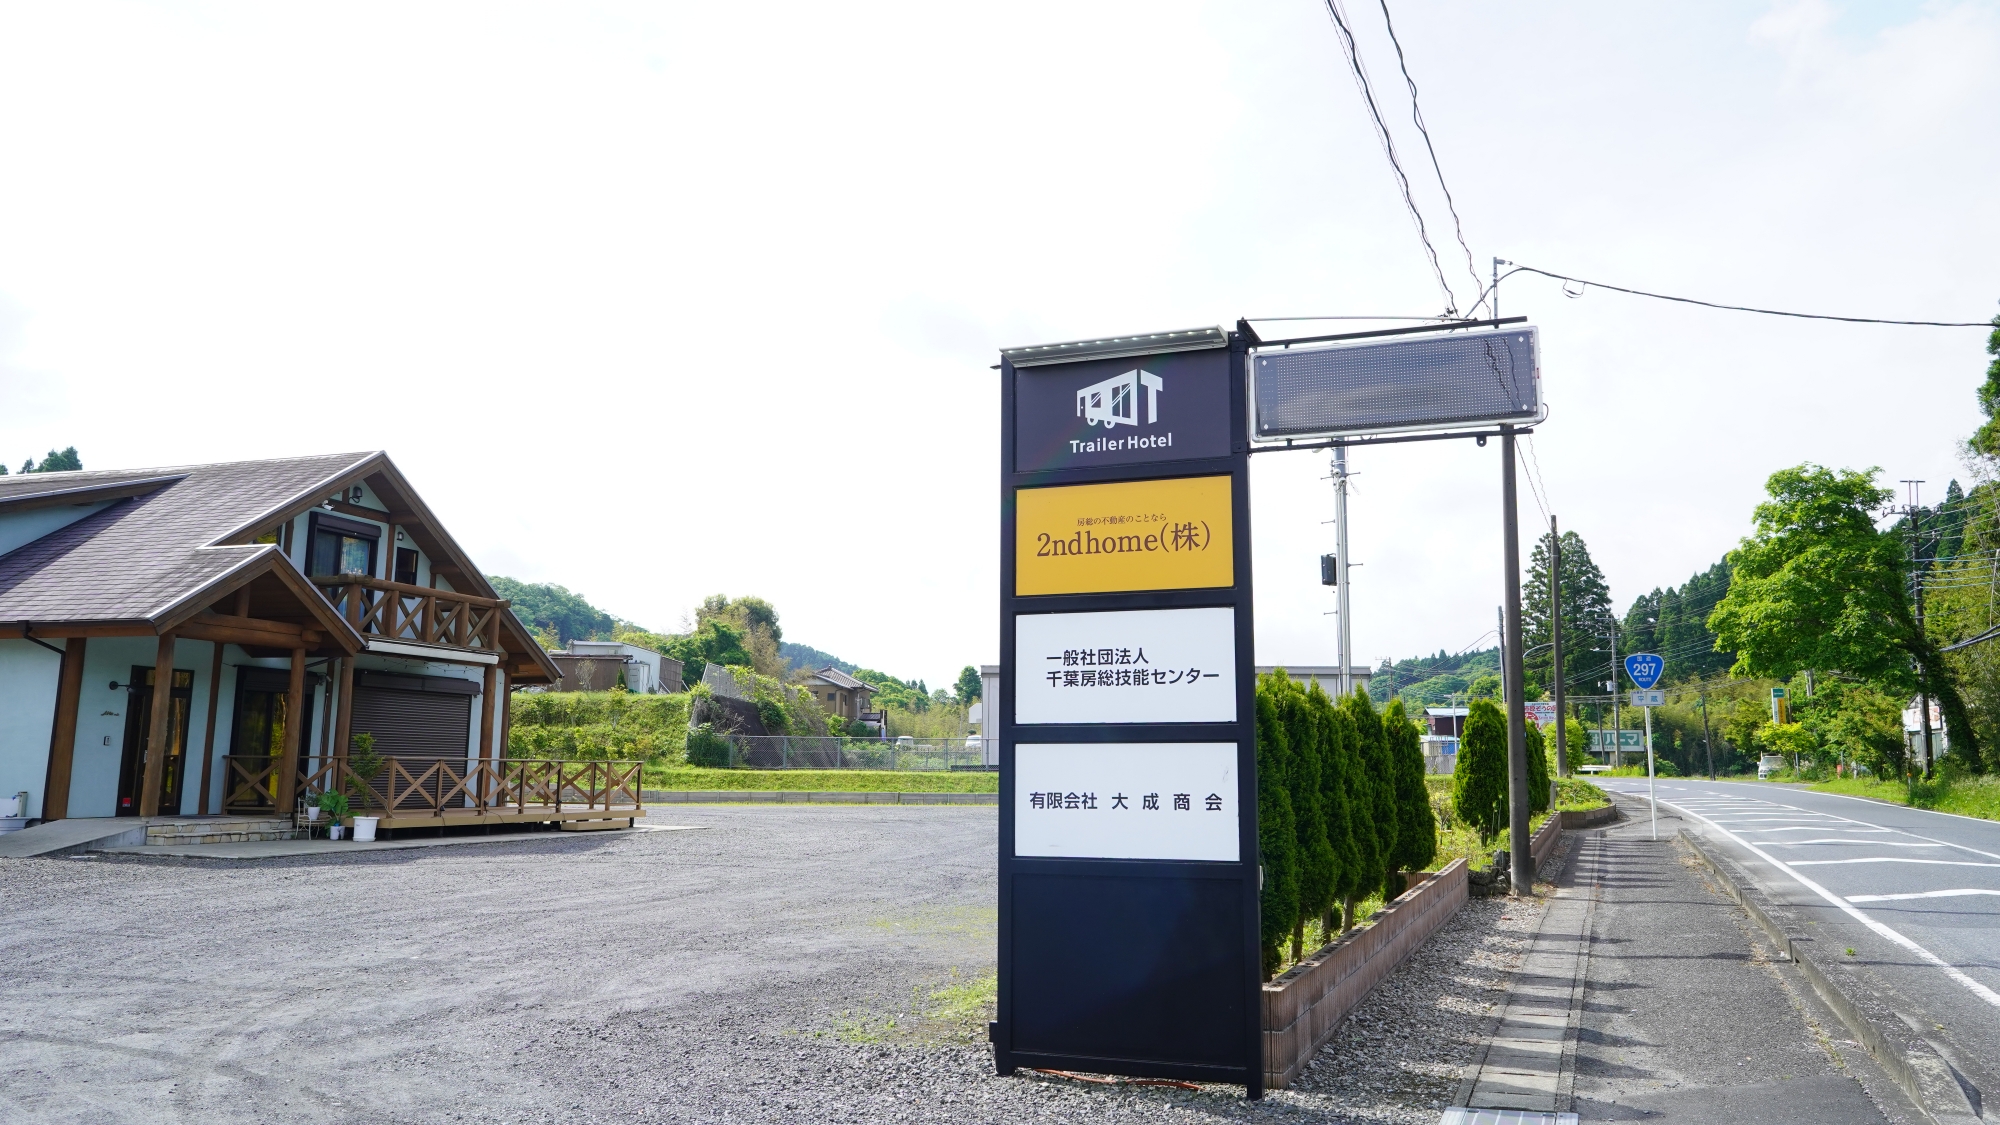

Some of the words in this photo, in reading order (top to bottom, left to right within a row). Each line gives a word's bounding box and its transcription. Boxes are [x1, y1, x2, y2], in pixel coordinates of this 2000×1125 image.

[1069, 437, 1124, 454] Trailer
[1127, 432, 1172, 450] Hotel
[1077, 513, 1167, 527] 房総の不動産のことなら
[1046, 647, 1149, 666] 一般社団法人
[1046, 667, 1220, 688] 千葉房総技能センター
[1633, 663, 1656, 676] 297
[1029, 791, 1098, 810] 有限会社
